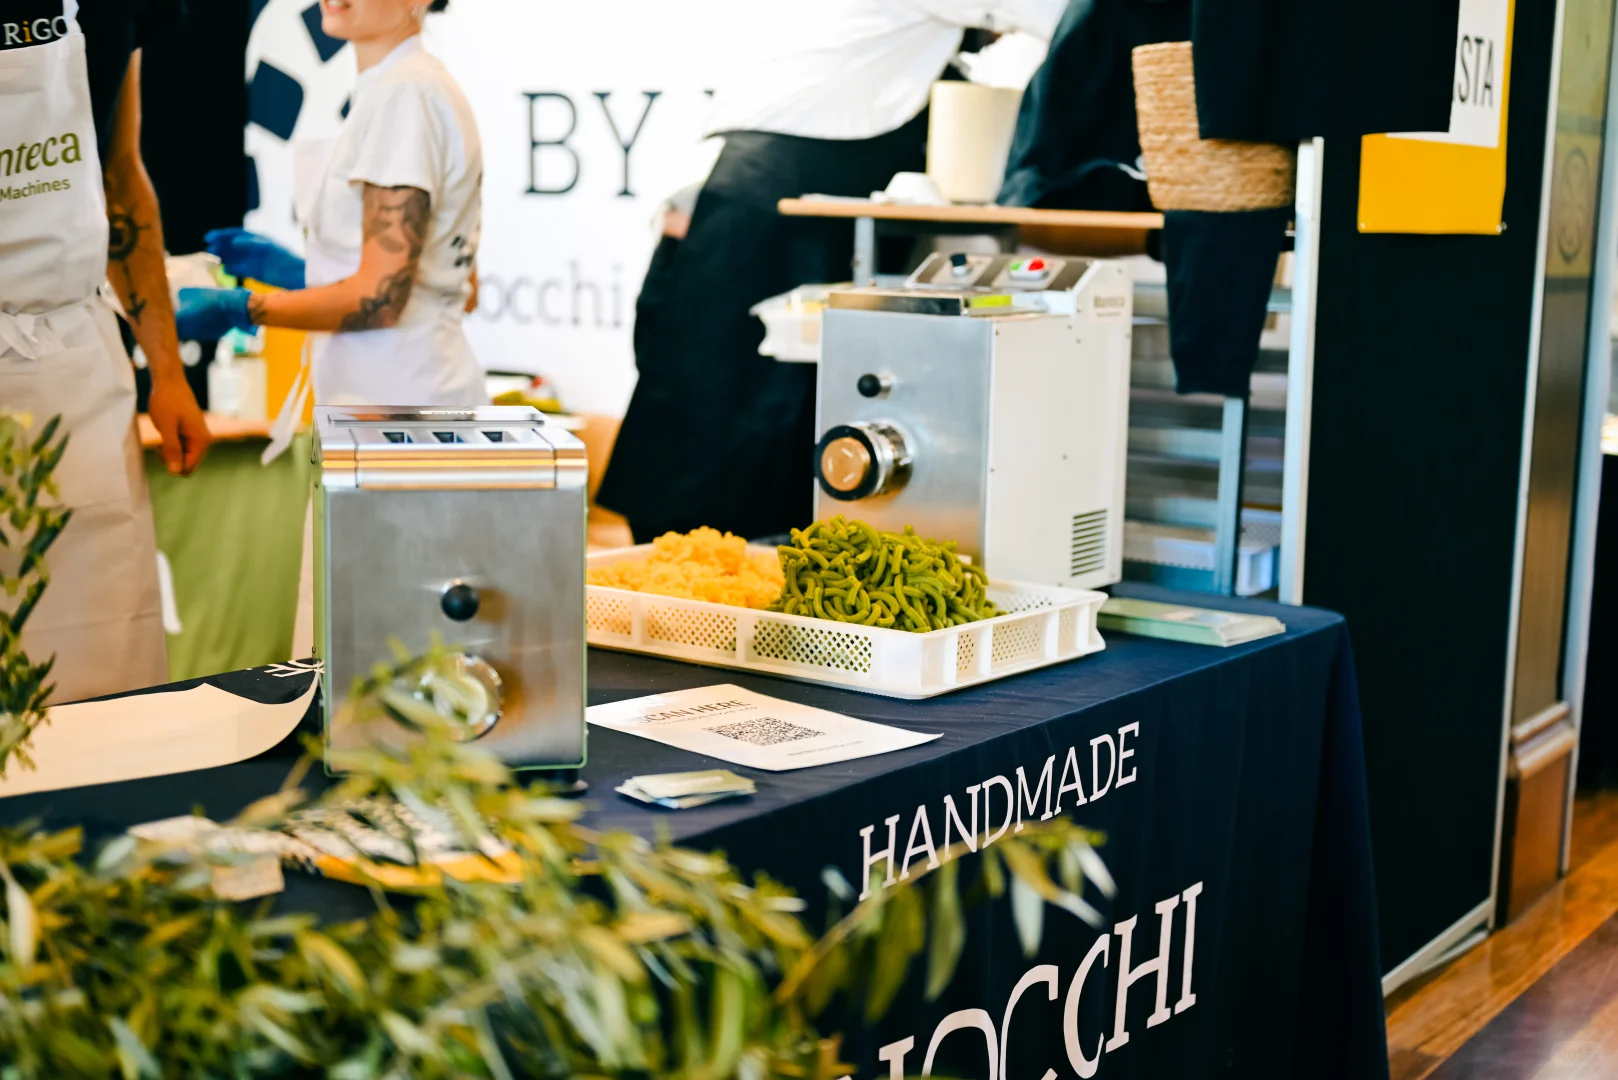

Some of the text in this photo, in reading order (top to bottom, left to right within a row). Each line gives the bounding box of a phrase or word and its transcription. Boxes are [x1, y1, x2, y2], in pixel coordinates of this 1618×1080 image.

[1458, 35, 1494, 107] STA
[522, 91, 662, 197] BY
[0, 178, 71, 202] Machines
[690, 699, 751, 714] HERE
[858, 721, 1140, 902] HANDMADE
